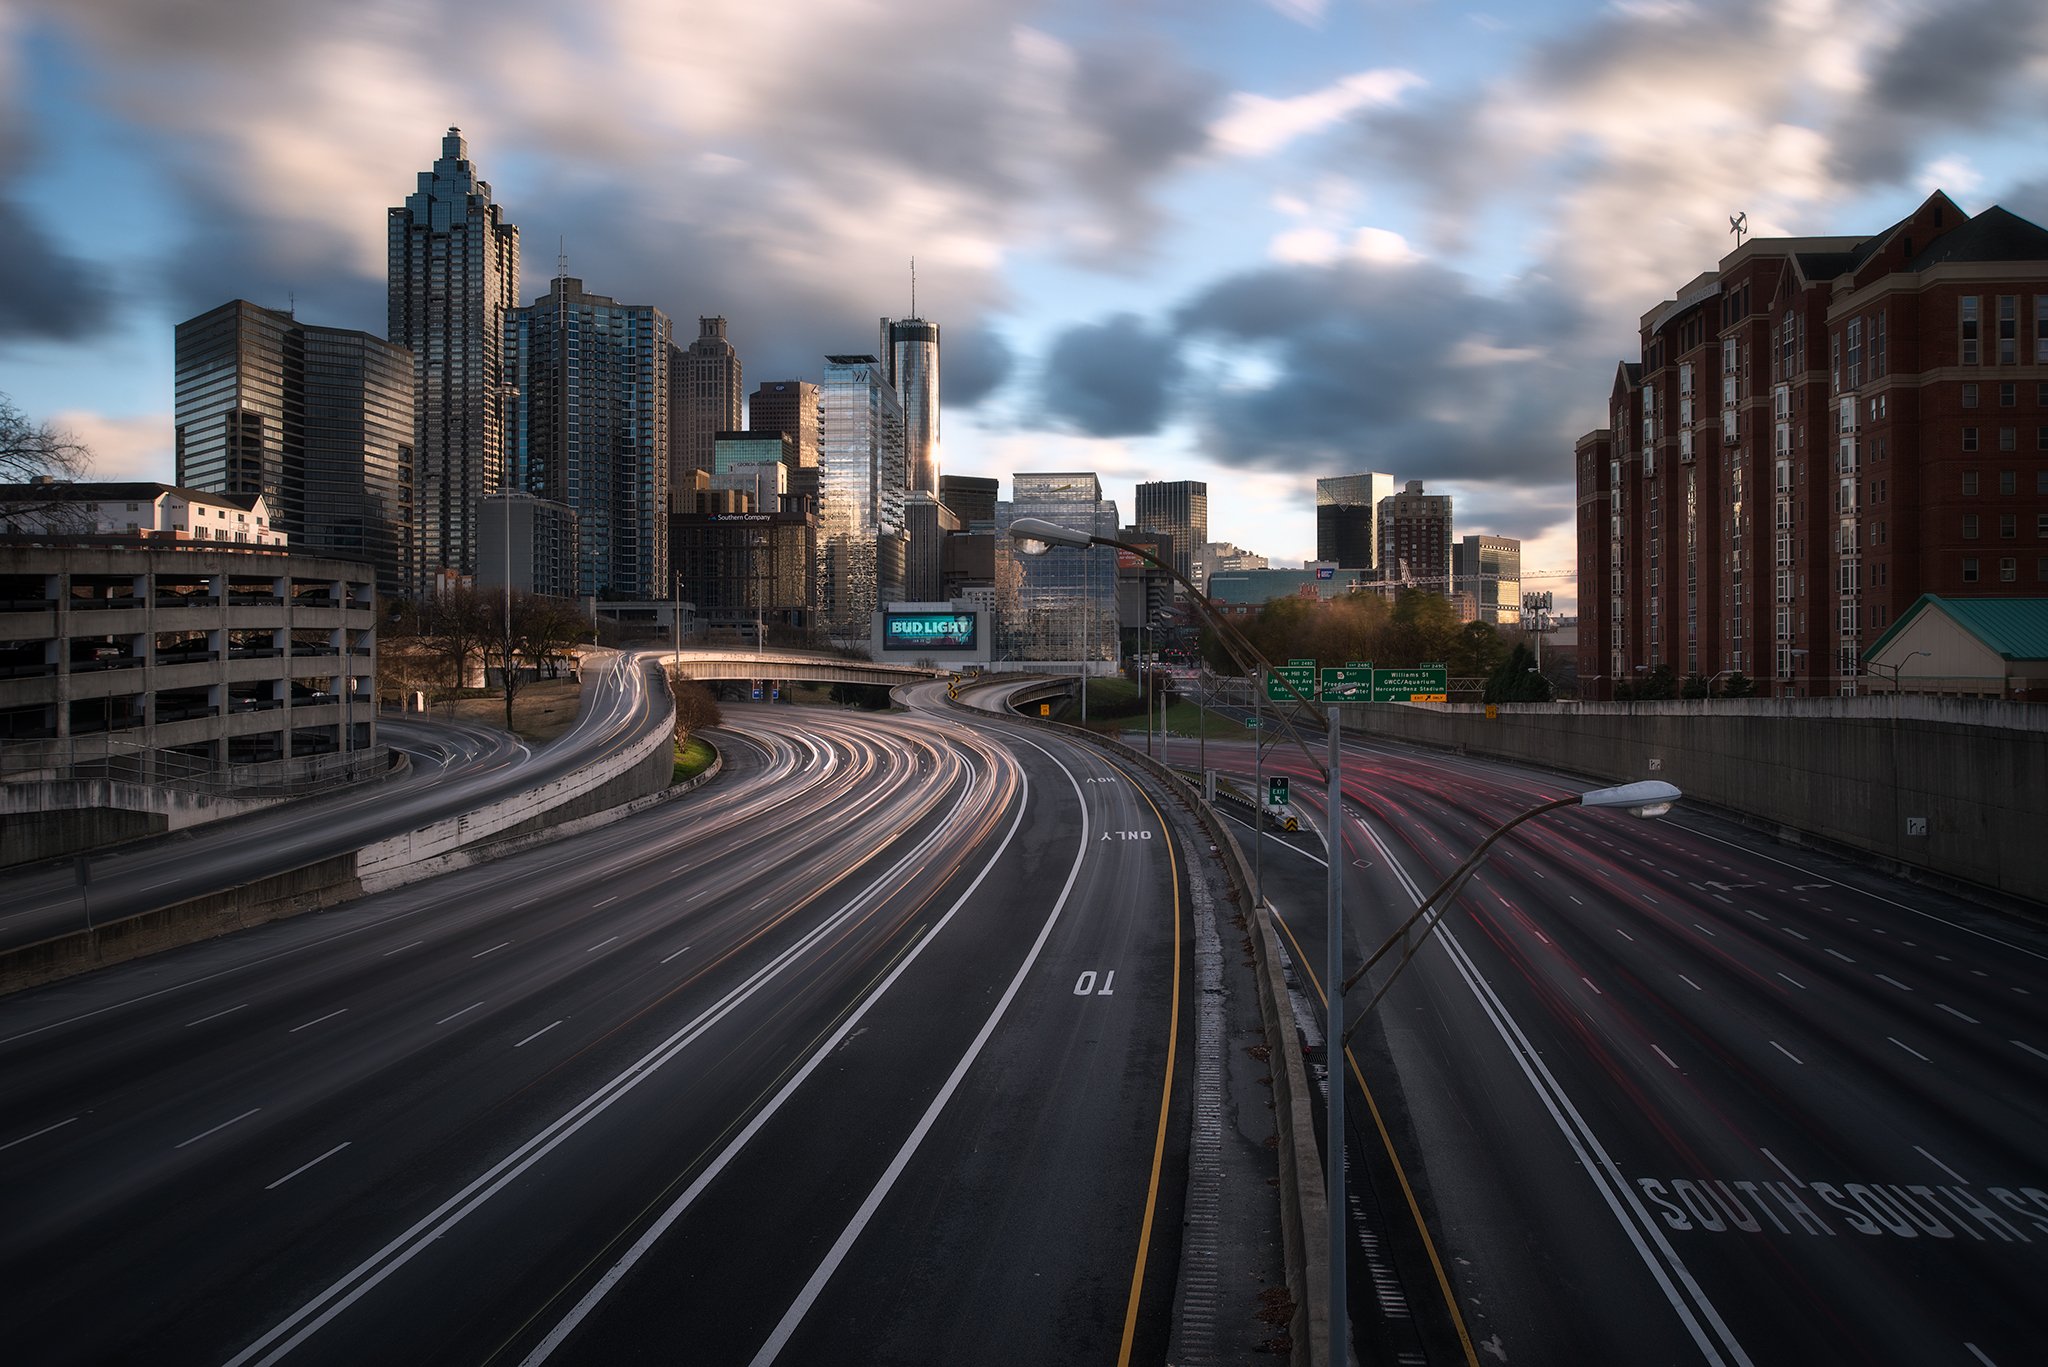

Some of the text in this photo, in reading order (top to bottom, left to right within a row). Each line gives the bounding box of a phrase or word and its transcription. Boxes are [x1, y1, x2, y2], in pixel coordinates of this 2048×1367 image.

[852, 370, 868, 382] W
[744, 514, 771, 522] Company
[892, 621, 968, 633] BUD LIGHT
[1100, 830, 1152, 841] ONLY
[1073, 970, 1115, 996] TO
[1637, 1178, 1836, 1236] SOUTH
[1810, 1181, 2032, 1243] SOUTH
